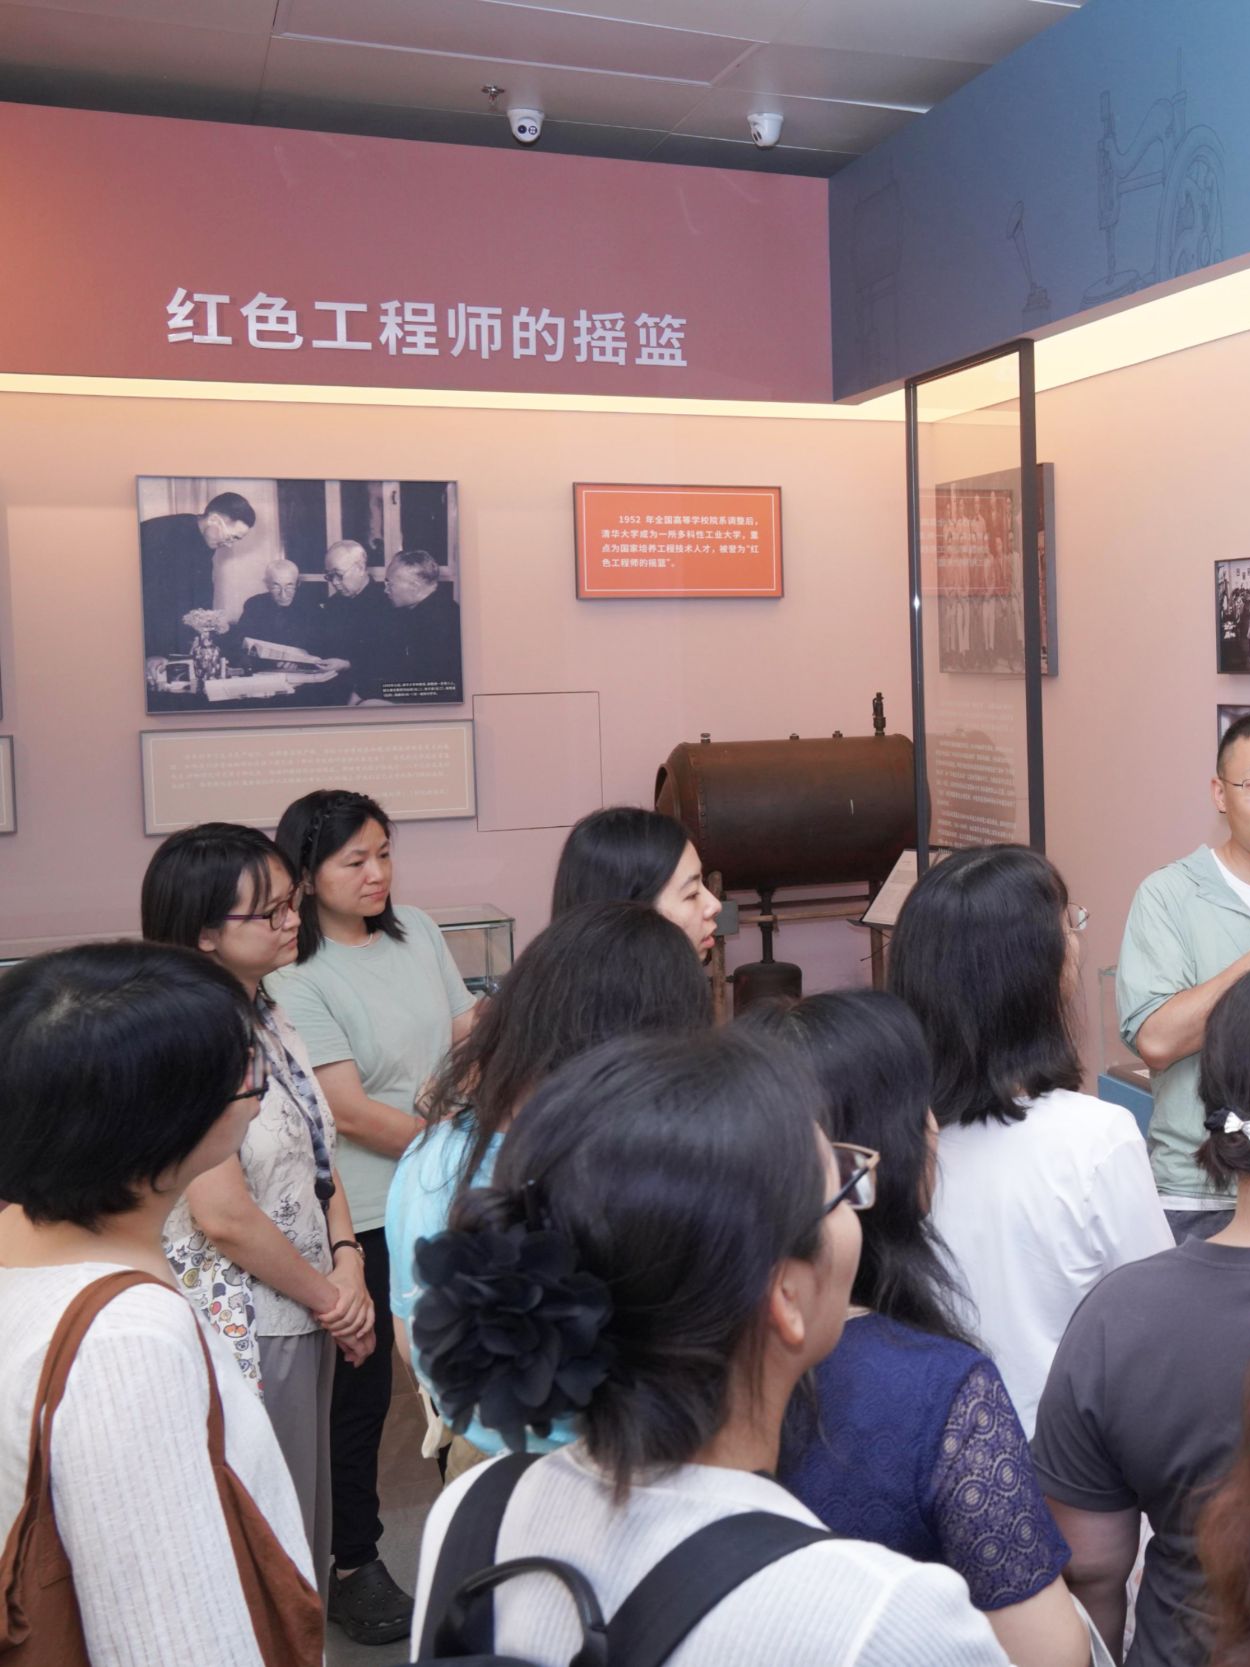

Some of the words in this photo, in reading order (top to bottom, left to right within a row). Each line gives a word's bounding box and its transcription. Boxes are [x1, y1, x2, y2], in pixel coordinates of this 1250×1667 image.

[166, 287, 688, 367] 红色工程师的摇篮
[619, 516, 641, 524] 1952
[646, 516, 759, 526] 年全国高等学校院系调整后，
[601, 529, 759, 540] 清华大学成为一所多科性工业大学，重
